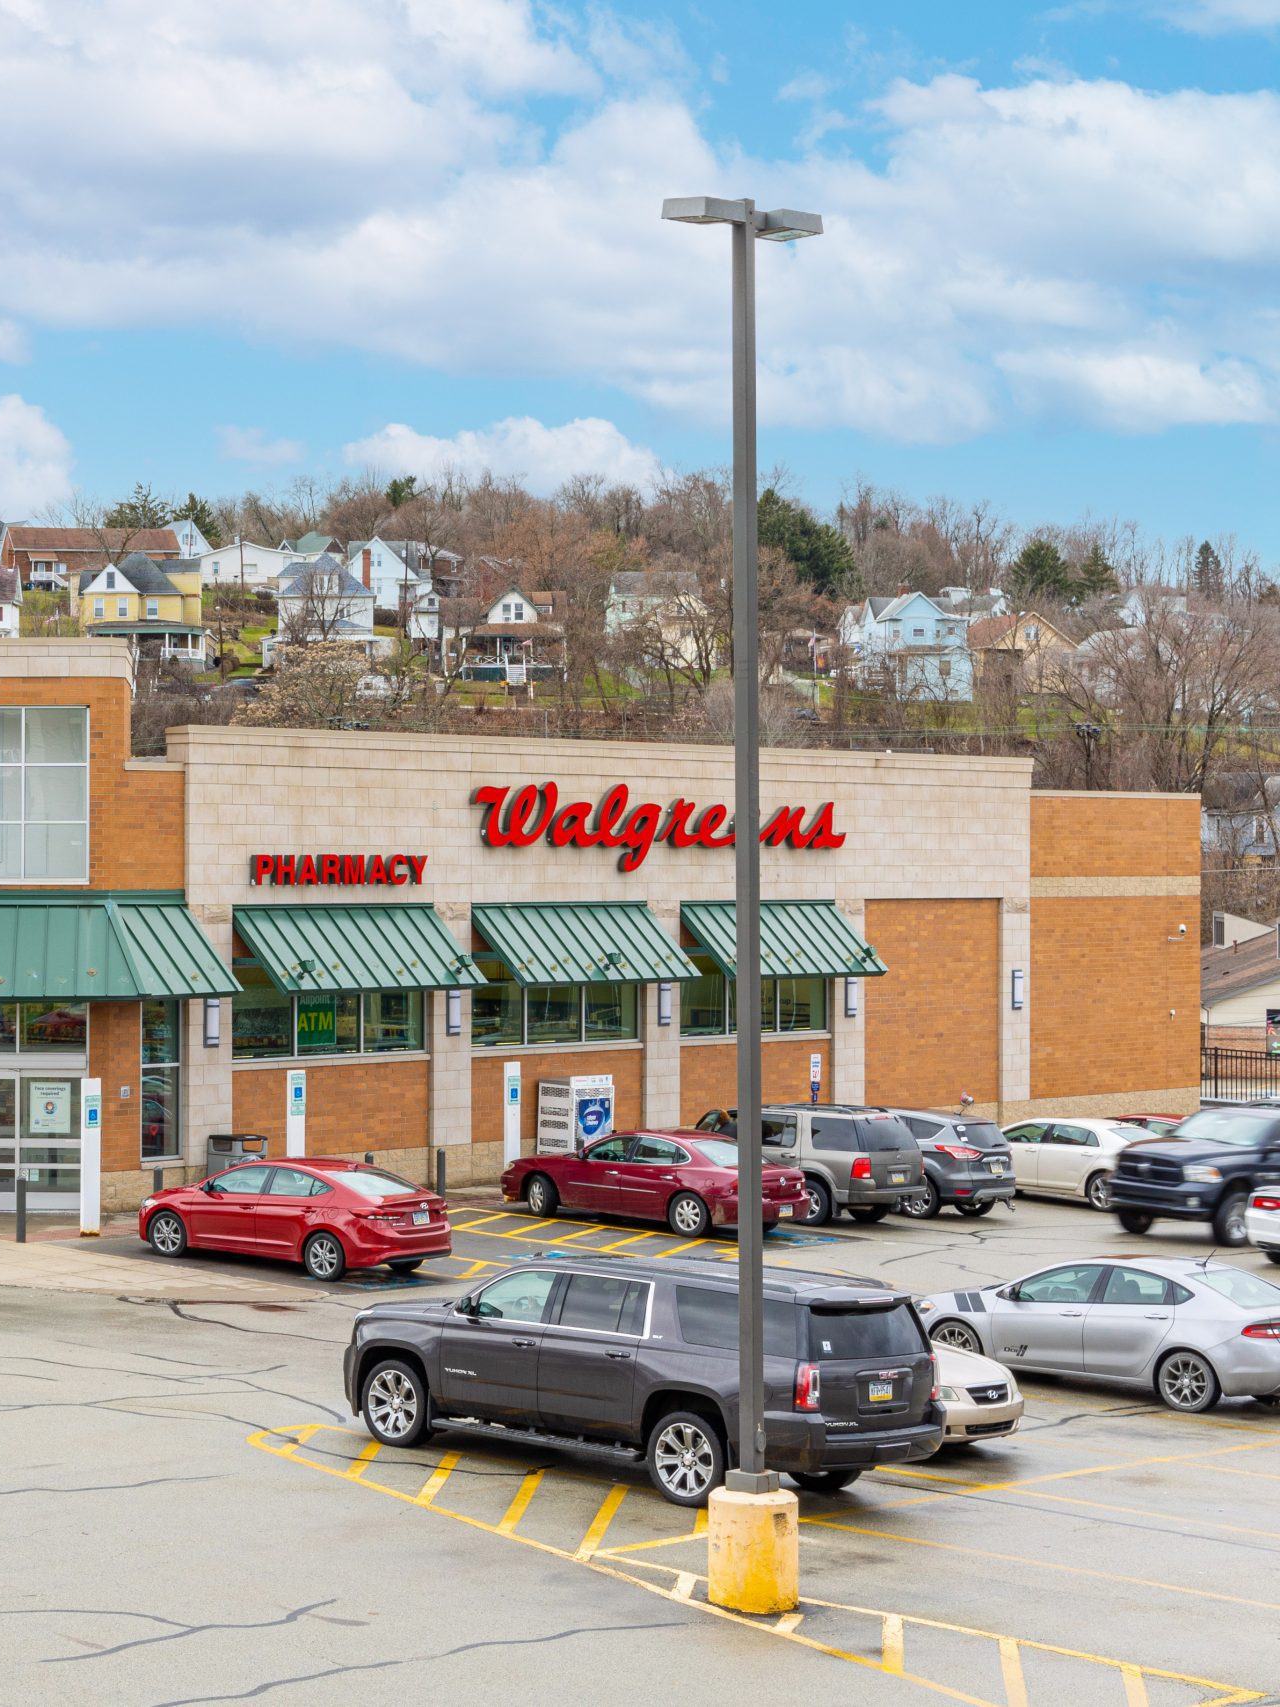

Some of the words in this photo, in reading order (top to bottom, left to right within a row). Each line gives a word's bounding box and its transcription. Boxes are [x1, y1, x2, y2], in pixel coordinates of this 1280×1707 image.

[472, 781, 847, 873] Walgrens
[253, 854, 428, 886] PHARMACY
[297, 1011, 333, 1032] ATM
